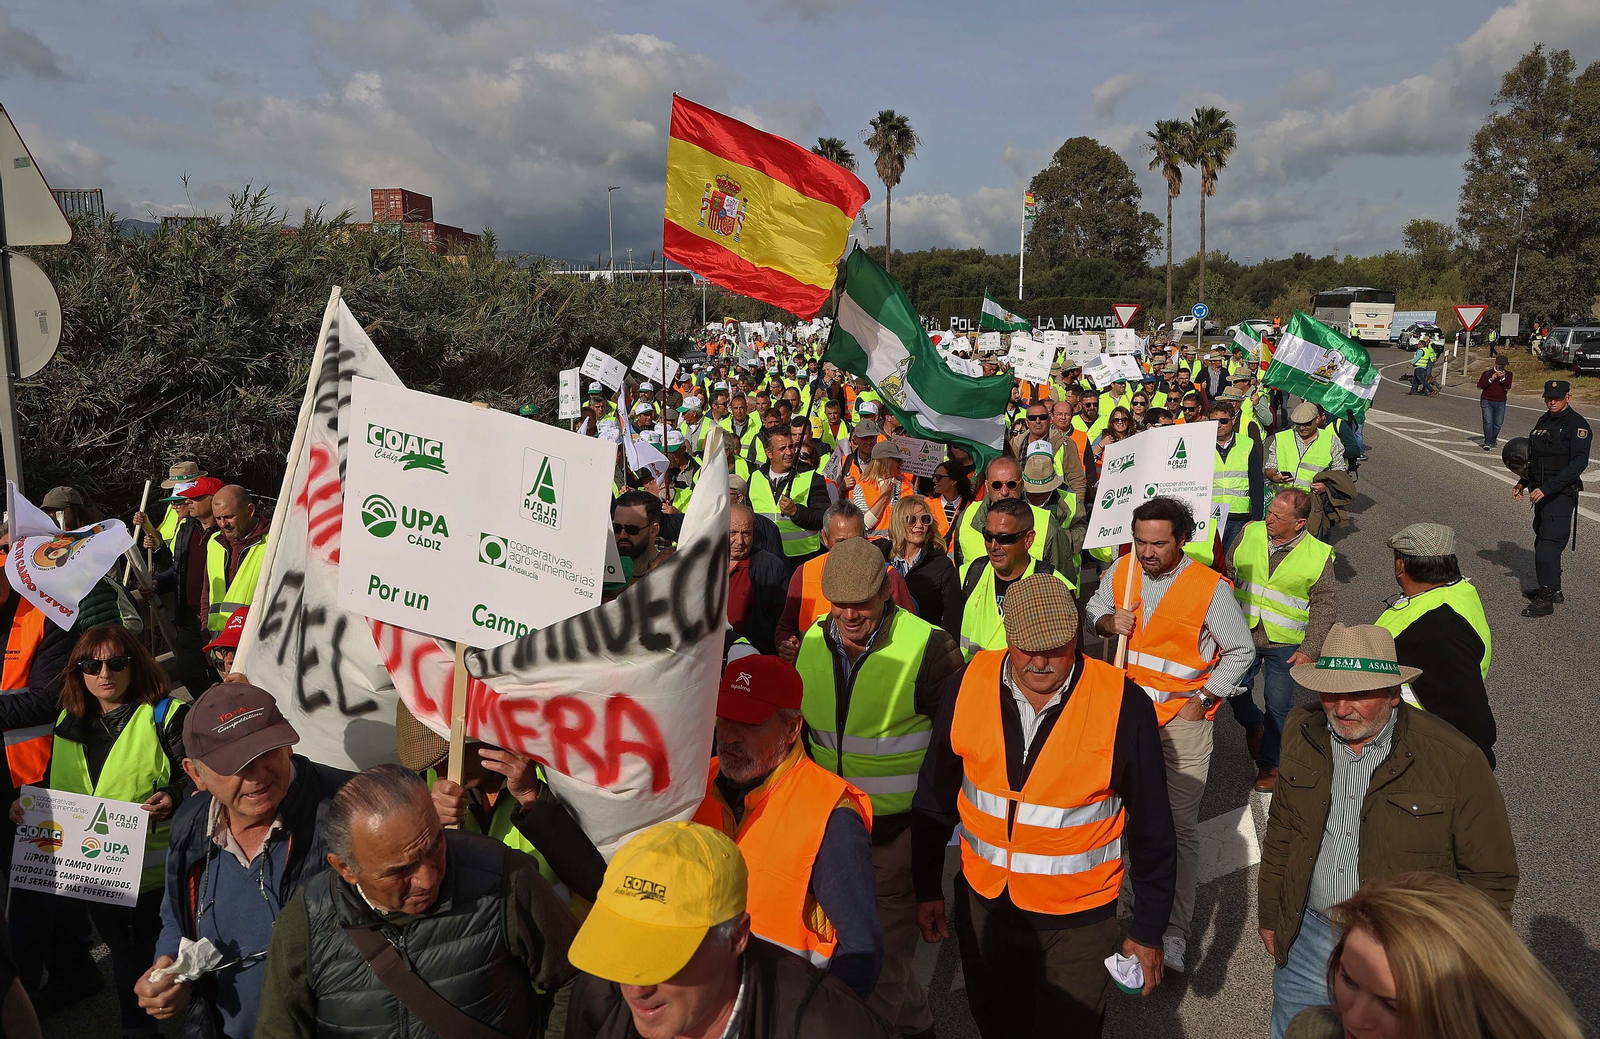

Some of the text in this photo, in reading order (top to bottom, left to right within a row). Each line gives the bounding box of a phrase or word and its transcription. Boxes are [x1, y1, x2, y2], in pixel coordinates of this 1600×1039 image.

[951, 316, 974, 330] POL
[1038, 315, 1056, 330] LA
[367, 424, 443, 459] COAG
[1117, 484, 1132, 498] UPA
[524, 500, 558, 519] ASAJA
[402, 506, 449, 538] UPA
[1098, 526, 1122, 537] Por un
[407, 534, 441, 551] CÁDIZ
[510, 540, 573, 570] cooperativas
[16, 559, 36, 591] CAMPO
[508, 551, 595, 588] agro-alimentarias
[368, 575, 429, 611] Por un
[574, 587, 594, 598] Cádiz
[217, 706, 254, 722] TOTAL
[108, 812, 139, 824] ASAJA
[16, 825, 62, 840] COAG
[104, 842, 130, 855] UPA
[52, 856, 62, 865] UN
[64, 858, 92, 871] CAMPO
[93, 864, 122, 876] VIVO!!!
[14, 874, 125, 900] ASÍ SEREMOS MÁS FUERTES!!!
[45, 868, 57, 877] LOS
[59, 871, 99, 885] CAMPEROS
[100, 878, 132, 890] UNIDOS,
[623, 876, 666, 896] COAG
